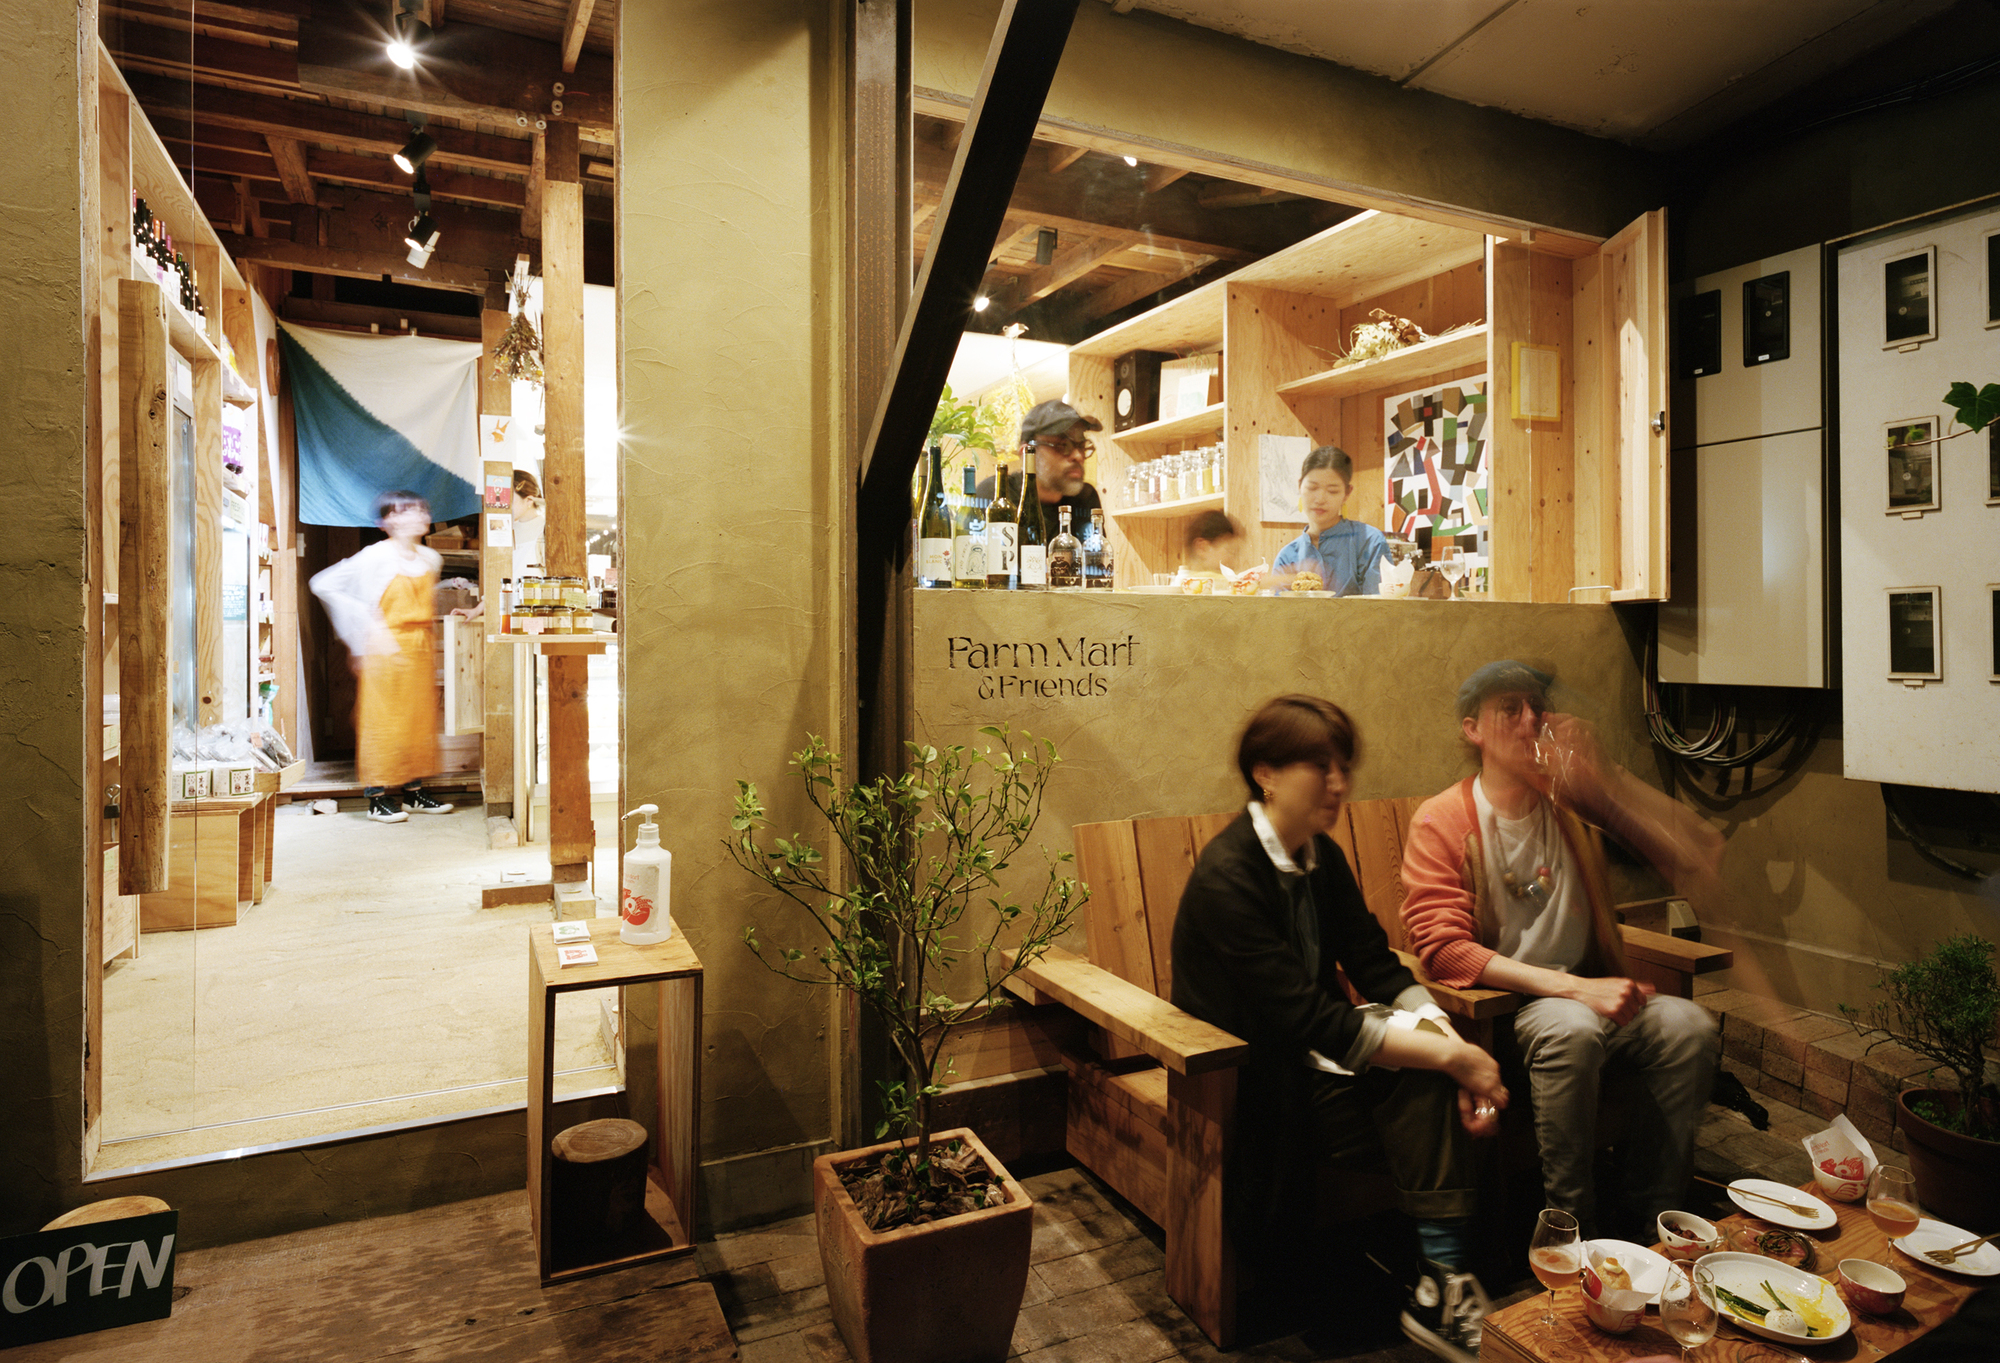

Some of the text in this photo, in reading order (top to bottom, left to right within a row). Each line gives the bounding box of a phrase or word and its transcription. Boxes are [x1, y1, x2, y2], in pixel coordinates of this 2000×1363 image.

[948, 635, 1141, 670] Farm Mart
[2, 1233, 176, 1314] OPEN
